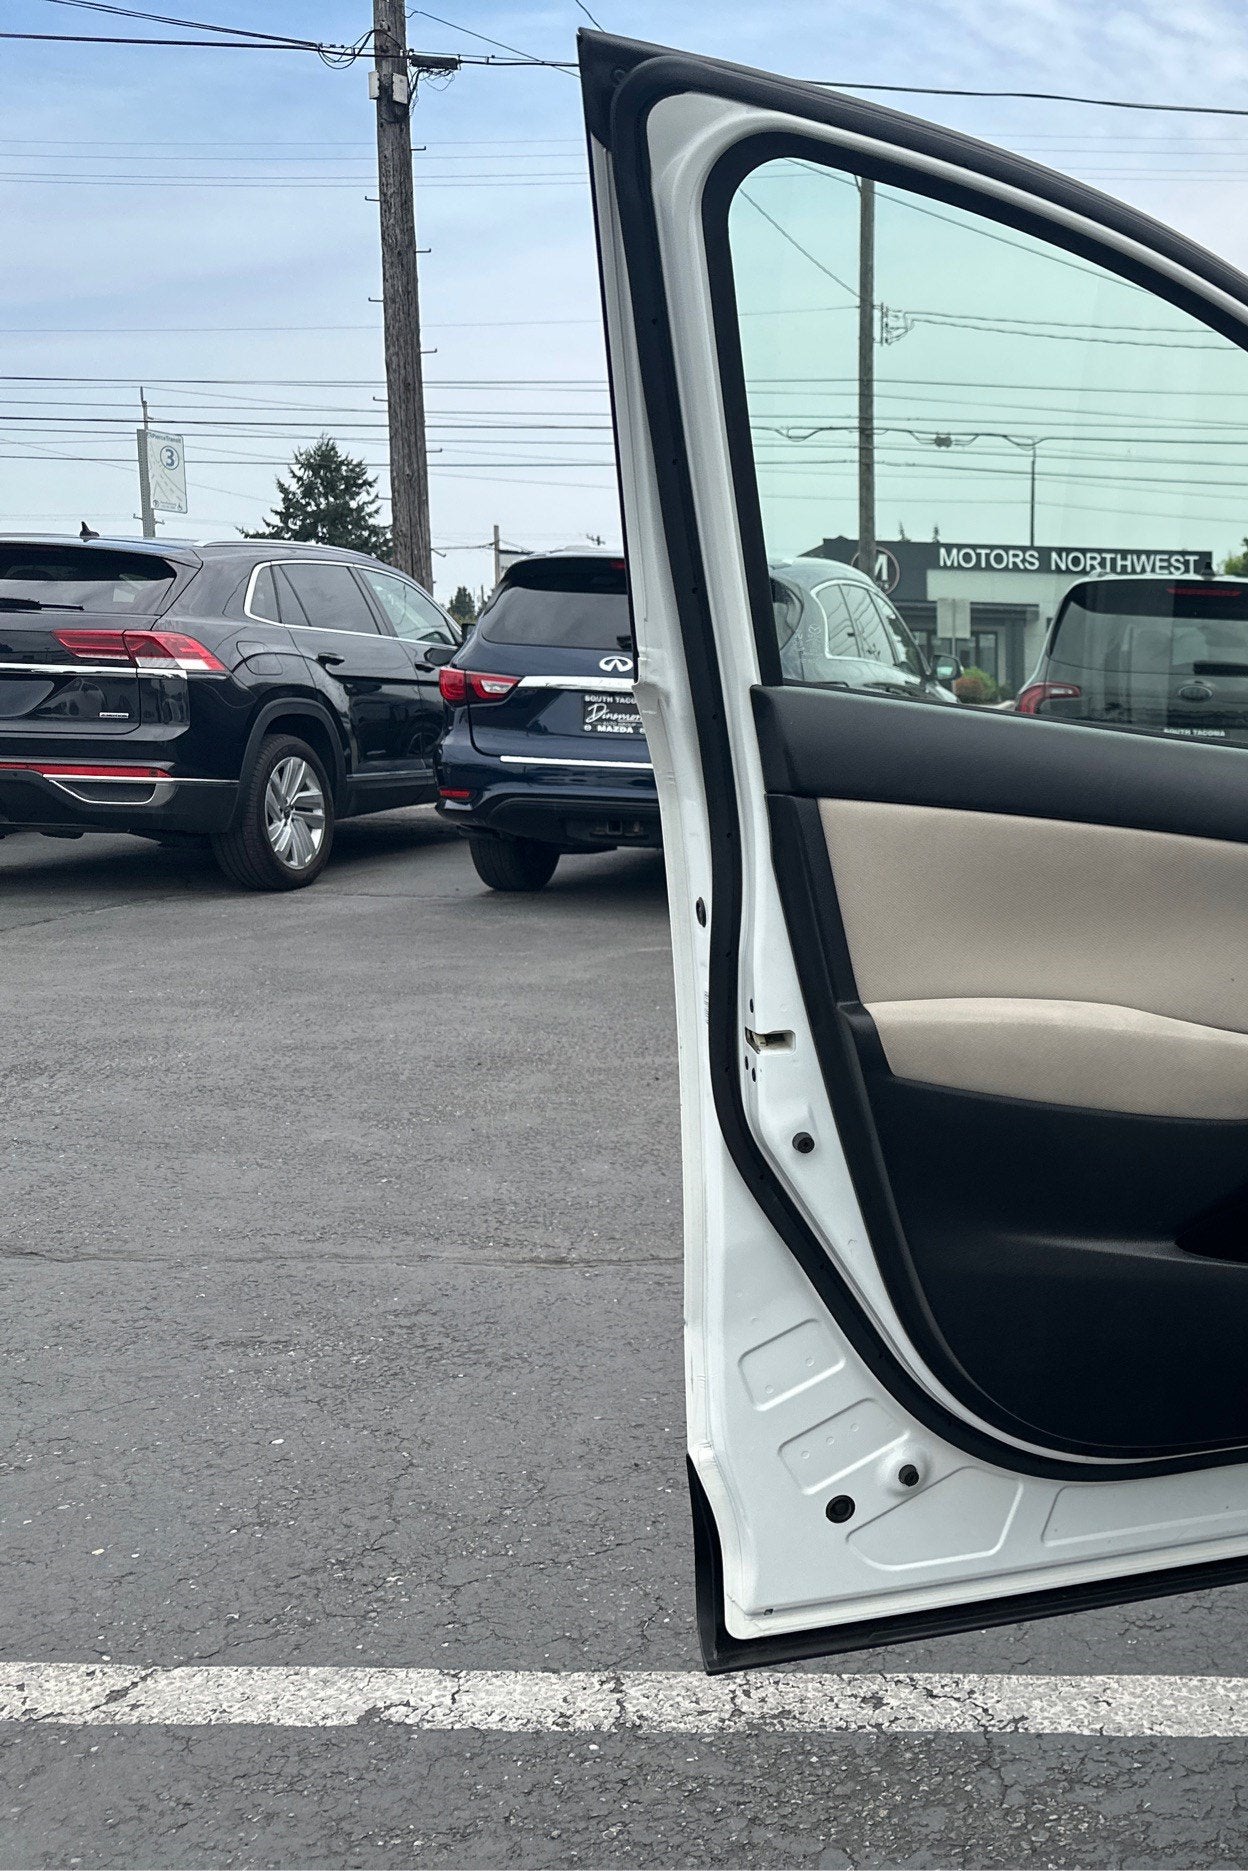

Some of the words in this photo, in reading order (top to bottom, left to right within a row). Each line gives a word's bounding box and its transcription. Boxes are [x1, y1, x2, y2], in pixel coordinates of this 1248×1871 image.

[165, 448, 175, 467] 3
[939, 546, 1040, 570] MOTORS
[1050, 551, 1200, 576] NORTHWEST
[585, 703, 642, 723] Dinsmor
[597, 725, 633, 733] MAZDA
